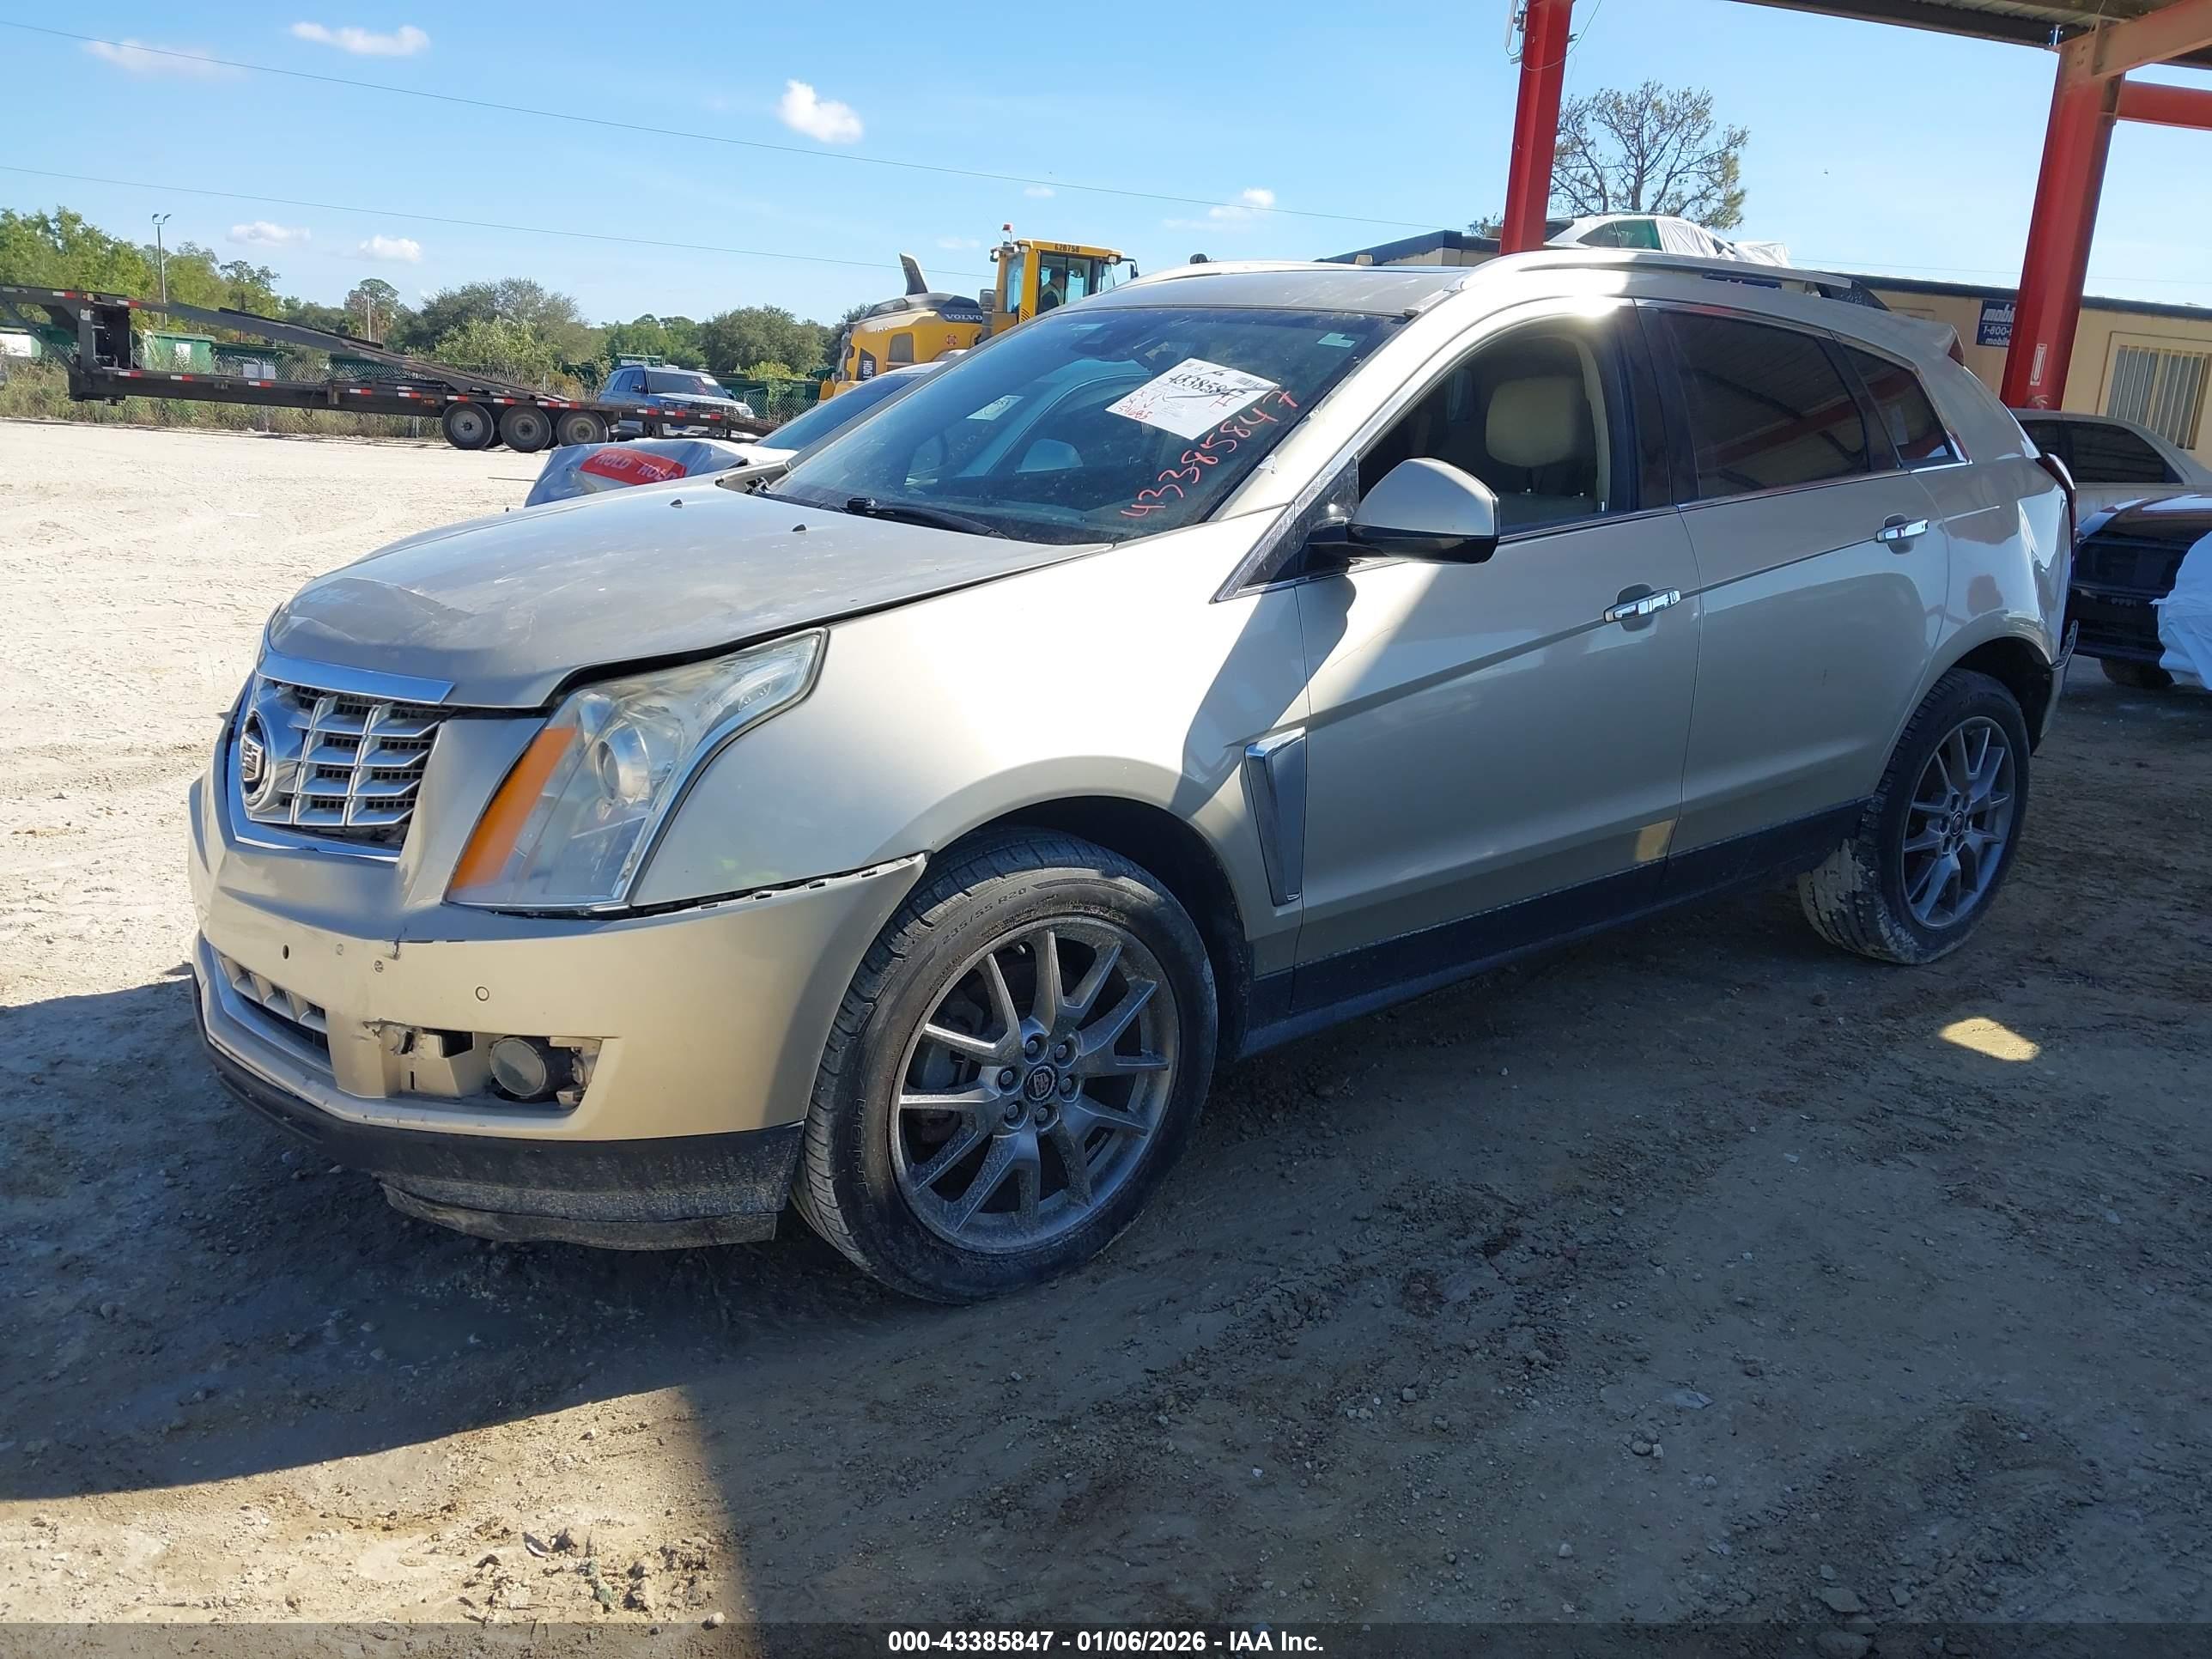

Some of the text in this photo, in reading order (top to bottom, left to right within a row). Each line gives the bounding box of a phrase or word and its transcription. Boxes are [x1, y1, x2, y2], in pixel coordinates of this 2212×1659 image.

[594, 453, 633, 470] HOLD
[1120, 389, 1298, 517] 43385847
[941, 902, 994, 945] 235/55
[998, 887, 1027, 904] R20
